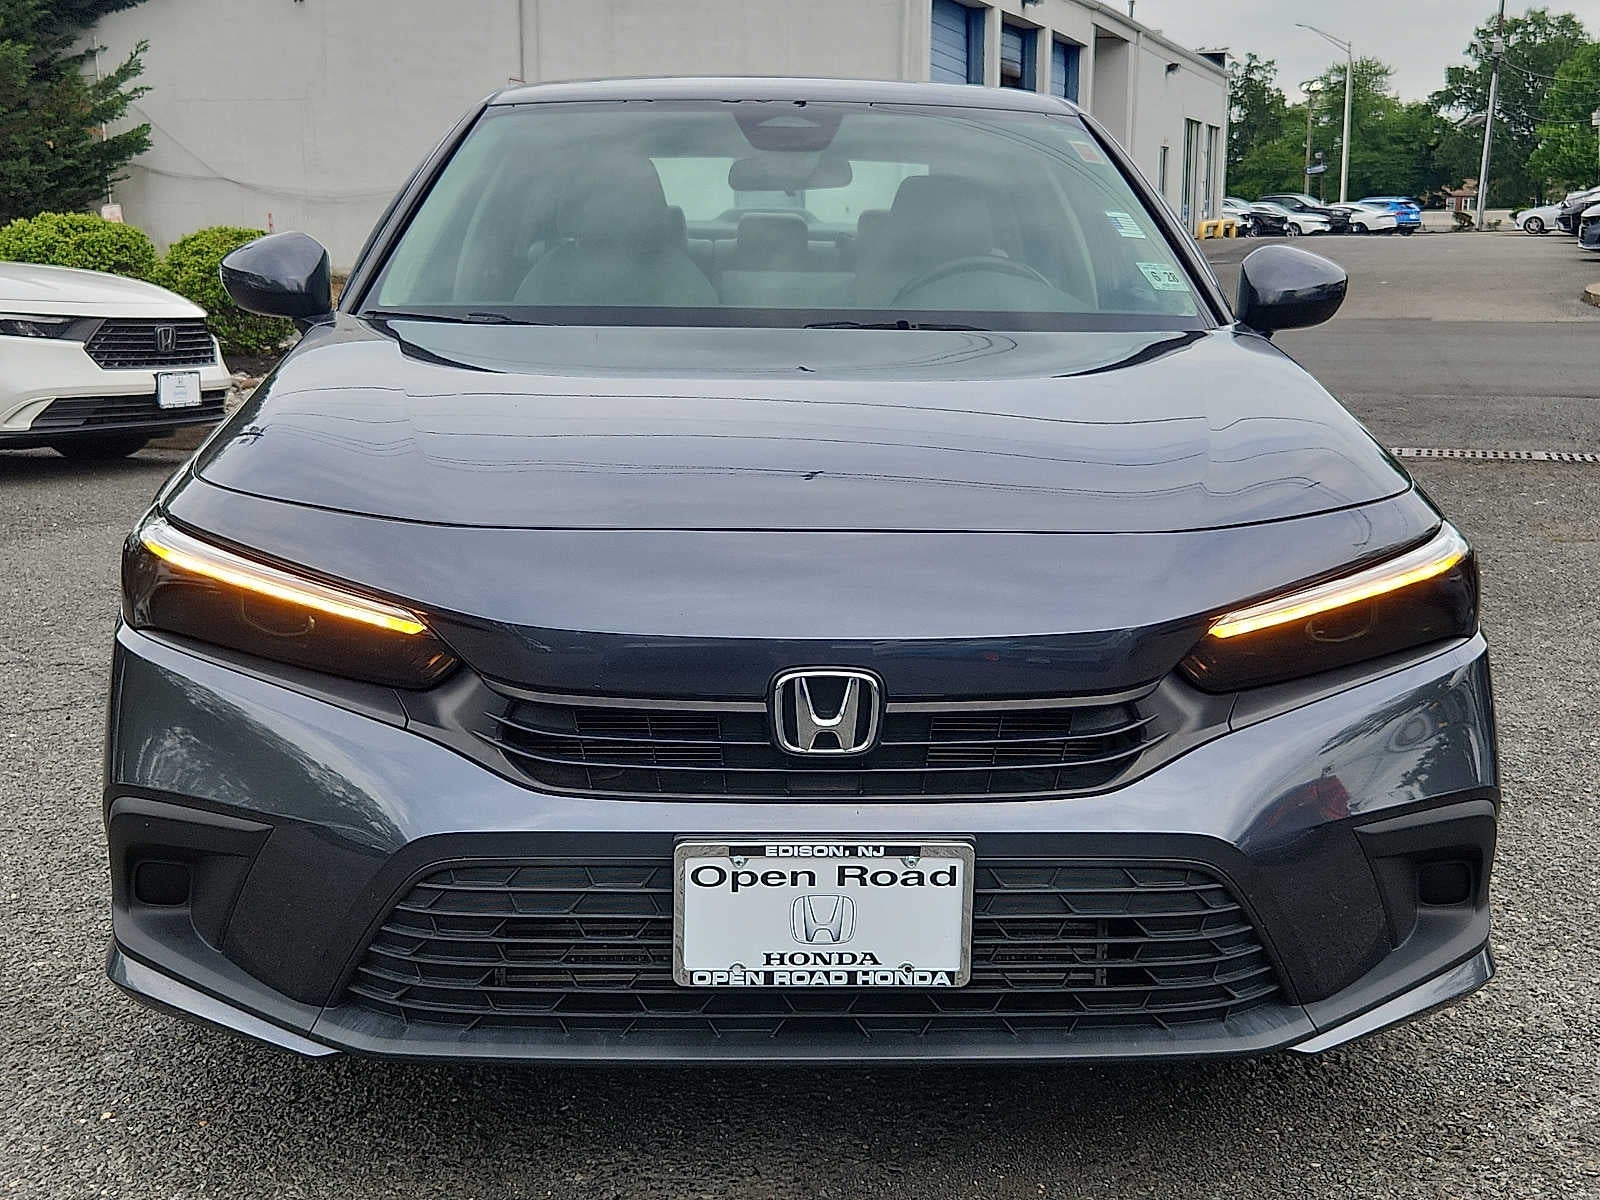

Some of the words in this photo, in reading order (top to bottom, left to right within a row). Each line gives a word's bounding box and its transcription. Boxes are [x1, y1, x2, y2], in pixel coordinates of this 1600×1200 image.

[765, 845, 850, 858] EDISON,
[857, 845, 885, 857] NJ
[690, 865, 816, 893] Open
[836, 865, 957, 888] Road
[762, 951, 882, 966] HONDA
[692, 970, 765, 987] OPEN
[773, 970, 849, 987] ROAD
[856, 970, 952, 987] HONDA
